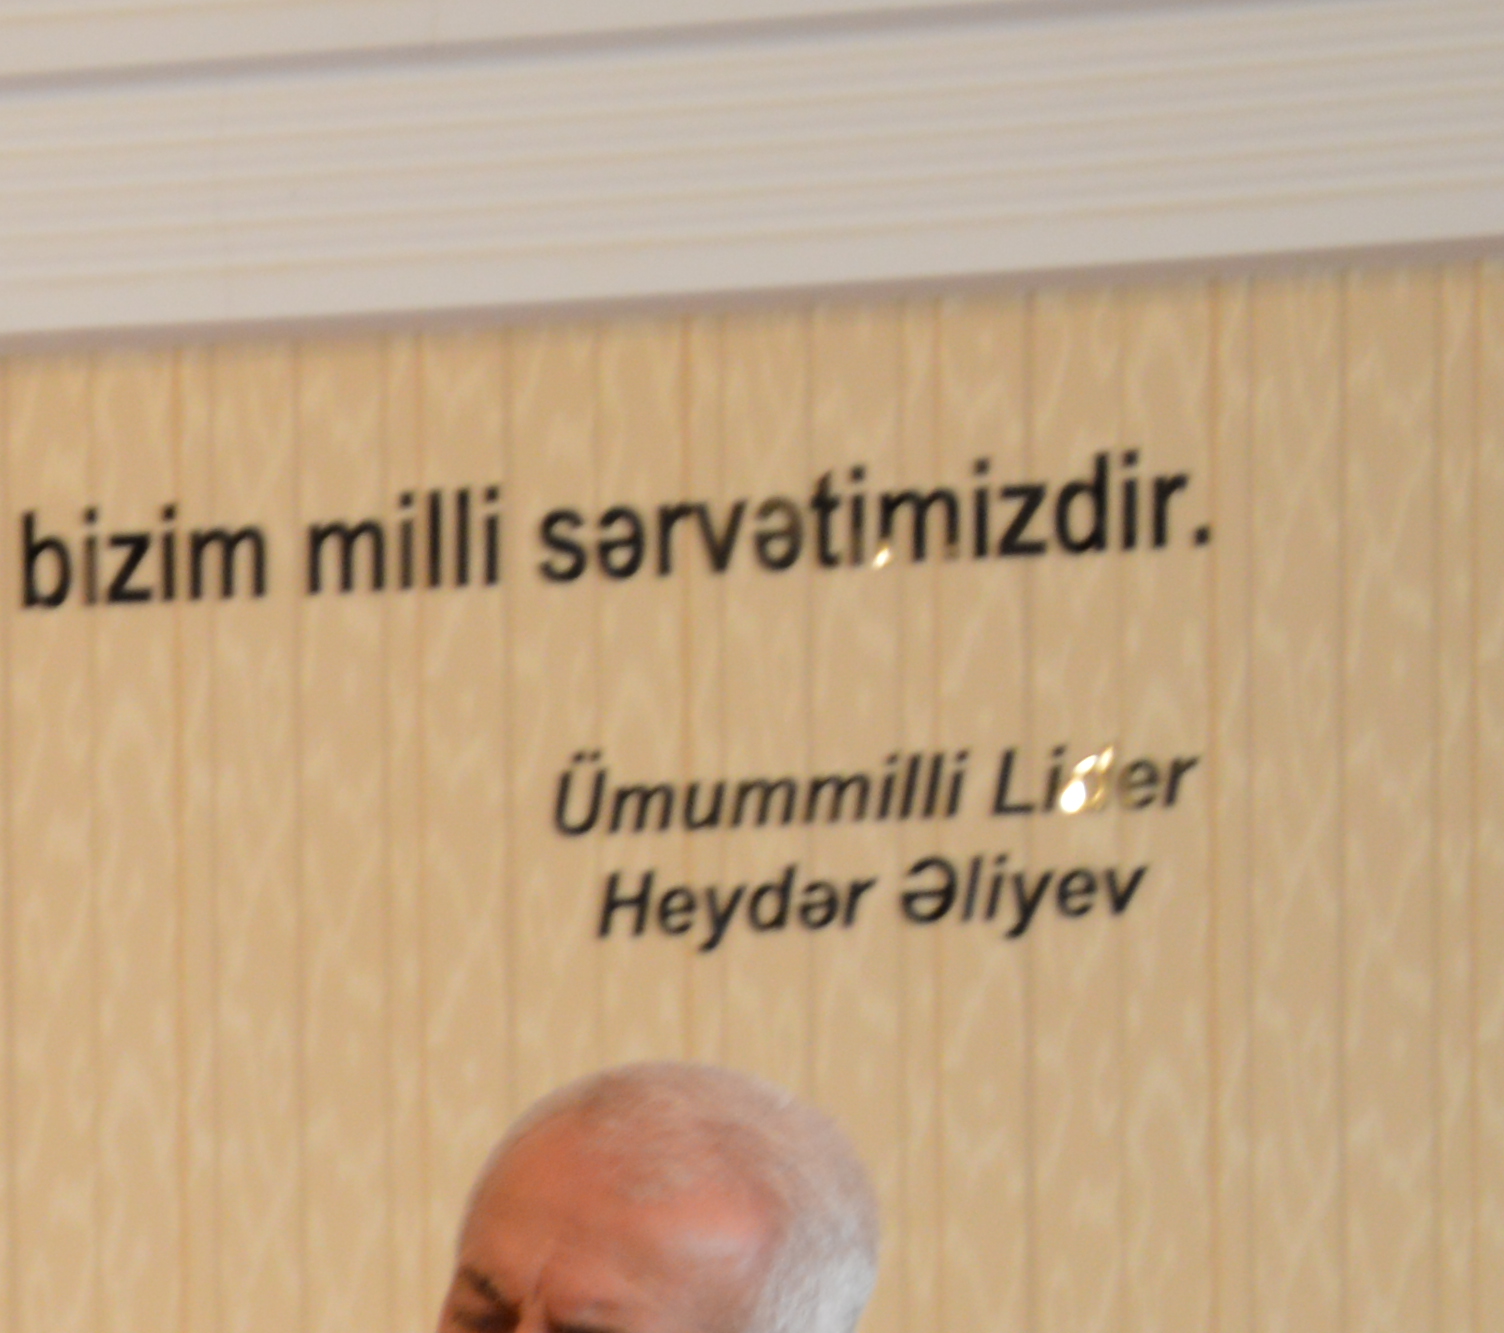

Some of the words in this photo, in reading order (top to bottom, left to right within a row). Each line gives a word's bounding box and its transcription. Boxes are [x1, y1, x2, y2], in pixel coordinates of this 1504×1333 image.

[19, 502, 268, 612] bizim
[305, 484, 502, 598] milli
[536, 447, 1213, 586] sərvətimizdir.
[551, 747, 970, 839] Ümummilli
[595, 863, 878, 952] Heydər
[897, 850, 1149, 942] Əliyev
